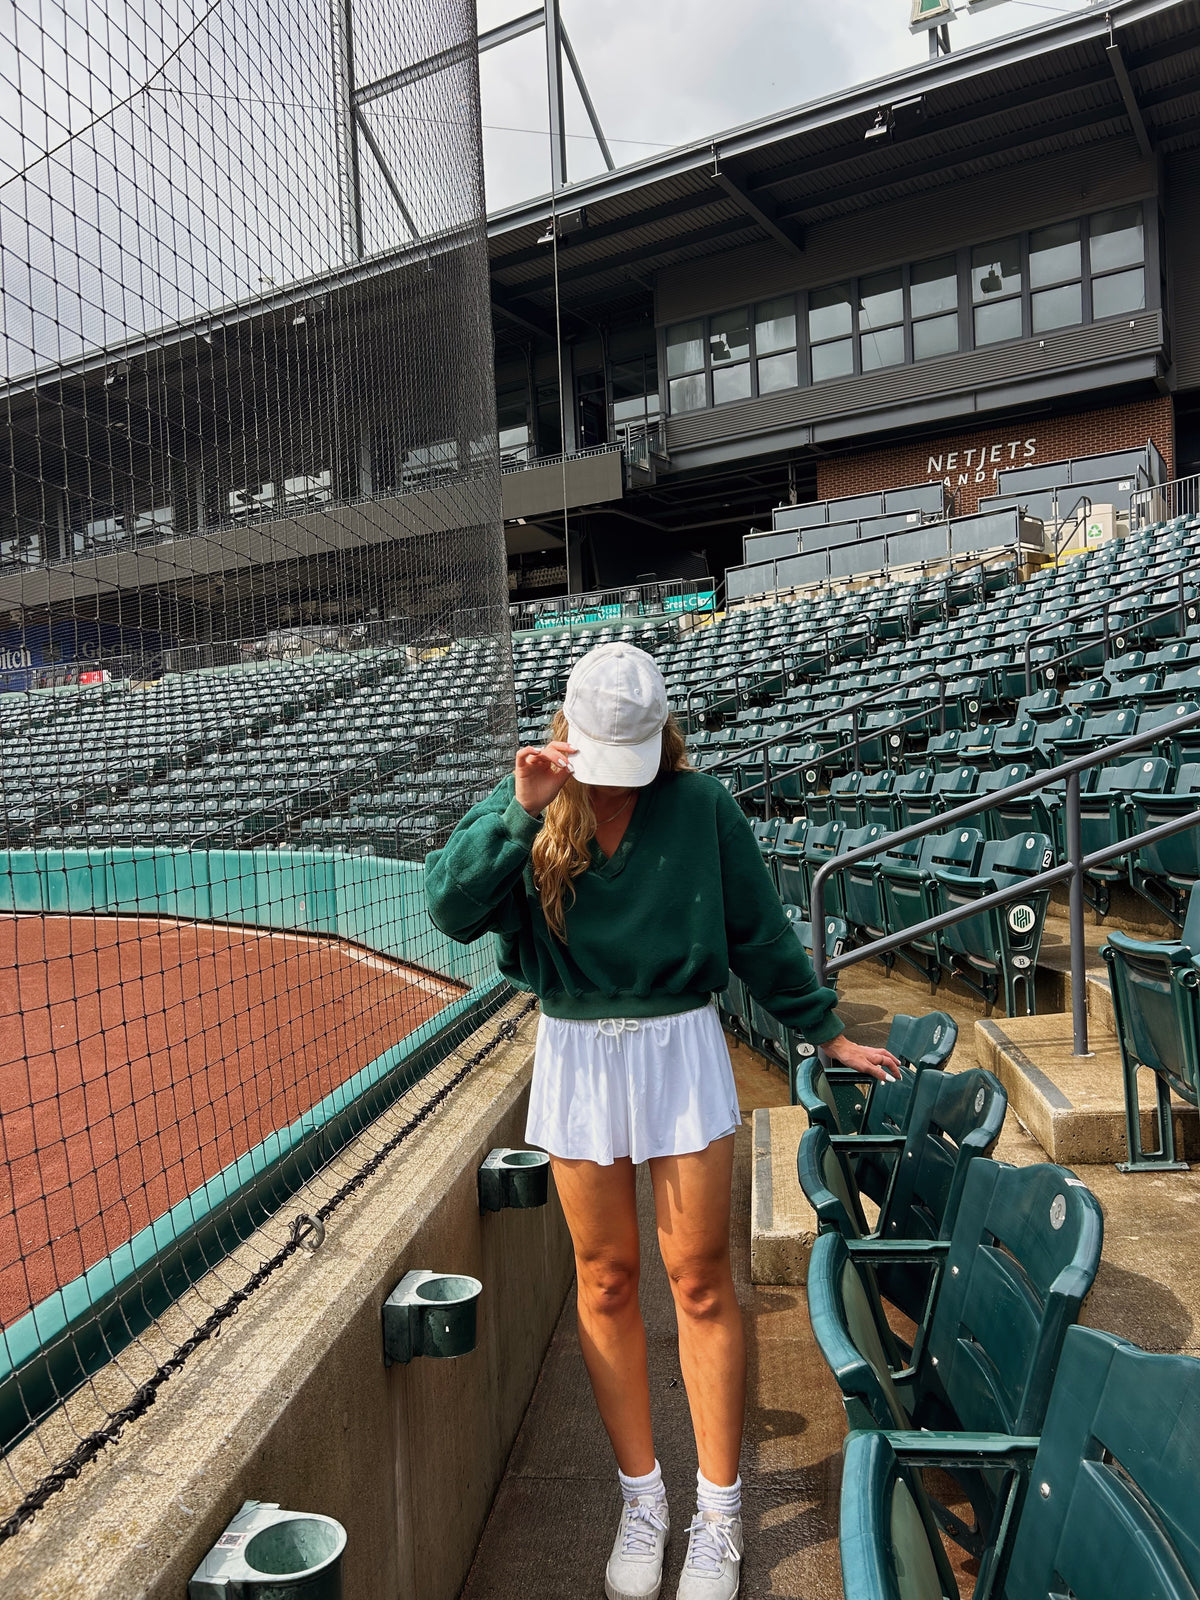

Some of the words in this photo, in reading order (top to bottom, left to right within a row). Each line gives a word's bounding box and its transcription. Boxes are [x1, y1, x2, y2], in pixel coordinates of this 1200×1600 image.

[927, 438, 1036, 473] NETJETS
[929, 462, 1034, 487] ANDI
[664, 599, 688, 610] Great
[0, 644, 32, 669] itch
[1043, 852, 1051, 866] 2
[1018, 958, 1025, 966] B
[803, 1045, 810, 1053] A
[1054, 1203, 1062, 1220] 3
